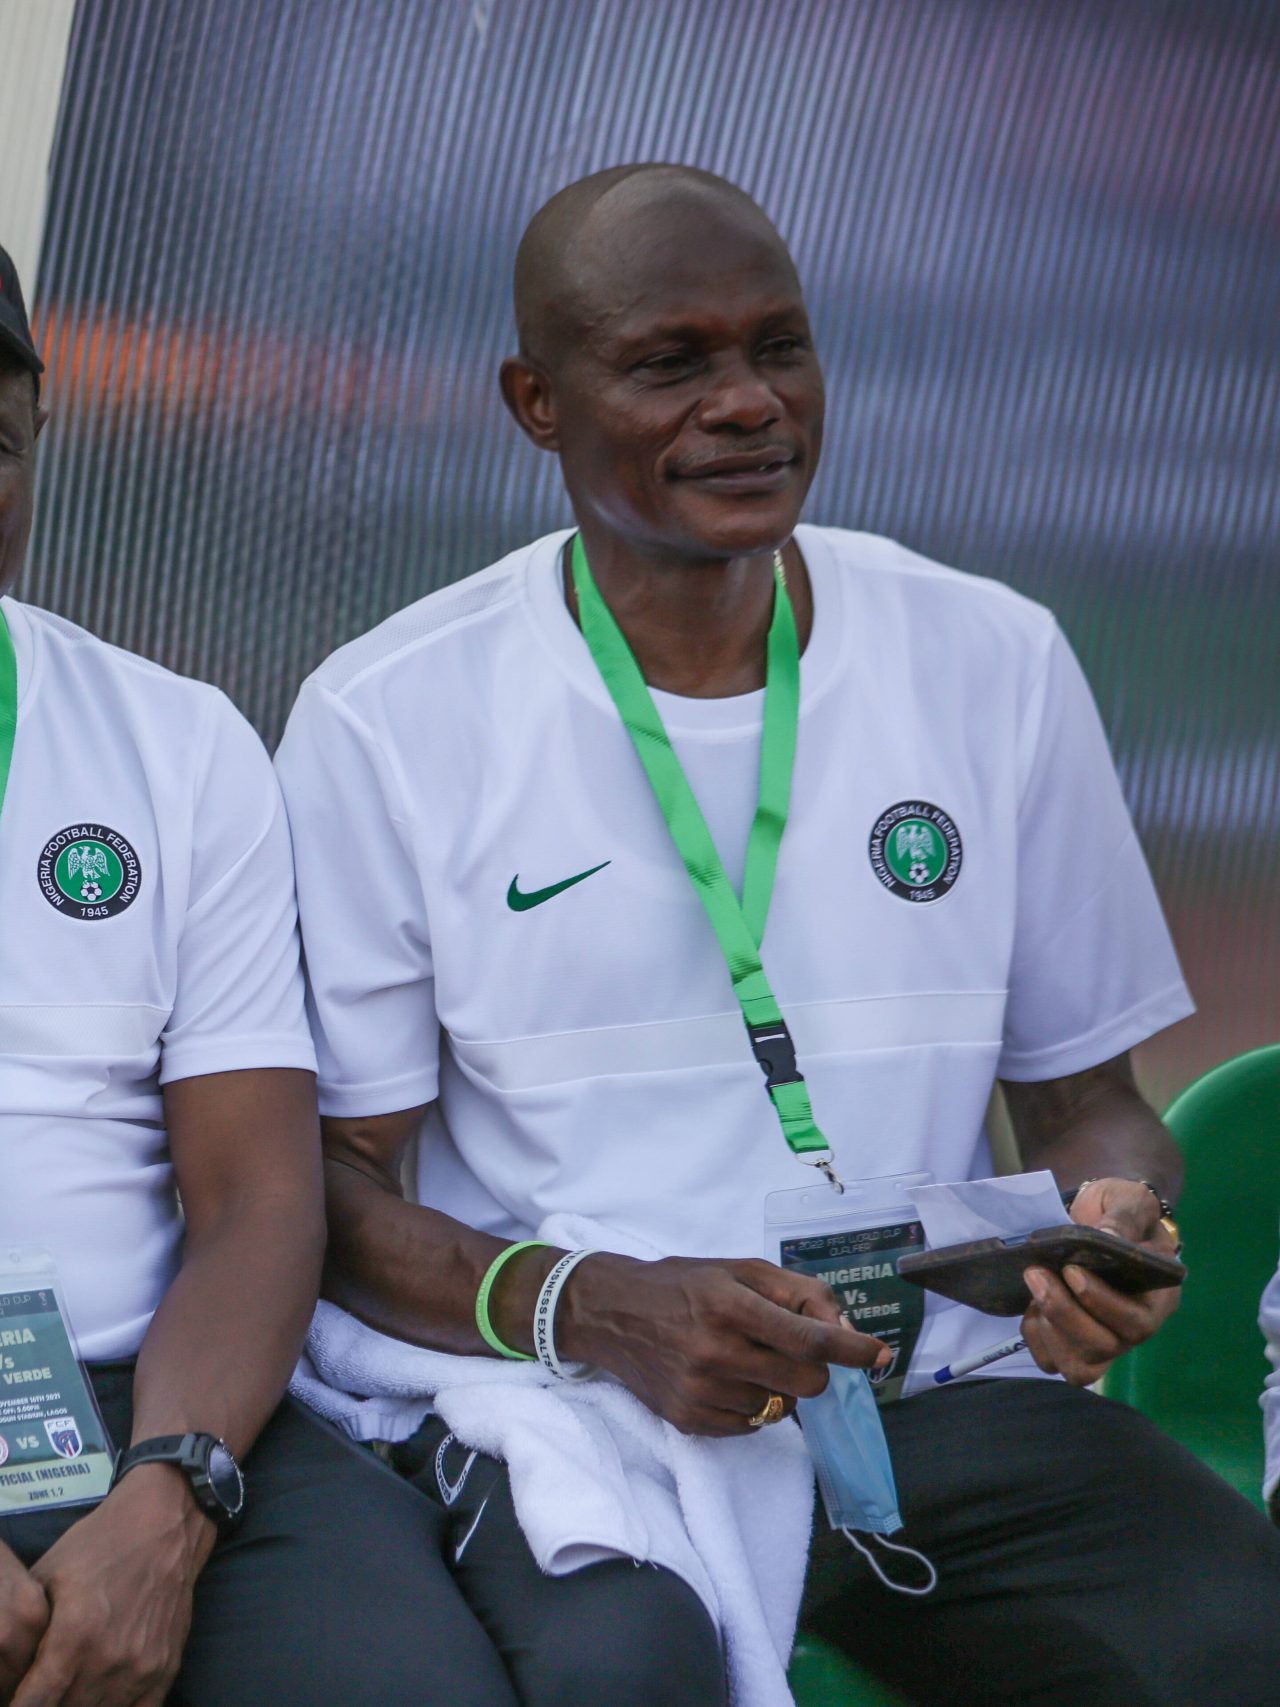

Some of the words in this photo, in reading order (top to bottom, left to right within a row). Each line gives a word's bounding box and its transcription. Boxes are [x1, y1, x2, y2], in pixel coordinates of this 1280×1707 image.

[874, 805, 930, 837] FOOTBALL
[44, 827, 104, 858] FOOTBALL
[931, 810, 960, 885] FEDERATION
[106, 832, 139, 903] FEDERATION
[871, 838, 896, 888] NIGERIA
[40, 859, 65, 907] NIGERIA
[81, 905, 108, 917] 1945
[816, 1263, 894, 1286] NIGERIA
[844, 1289, 868, 1306] Vs
[853, 1303, 900, 1320] VERDE
[537, 1319, 554, 1368] EXALTS
[3, 1367, 53, 1386] VERDE
